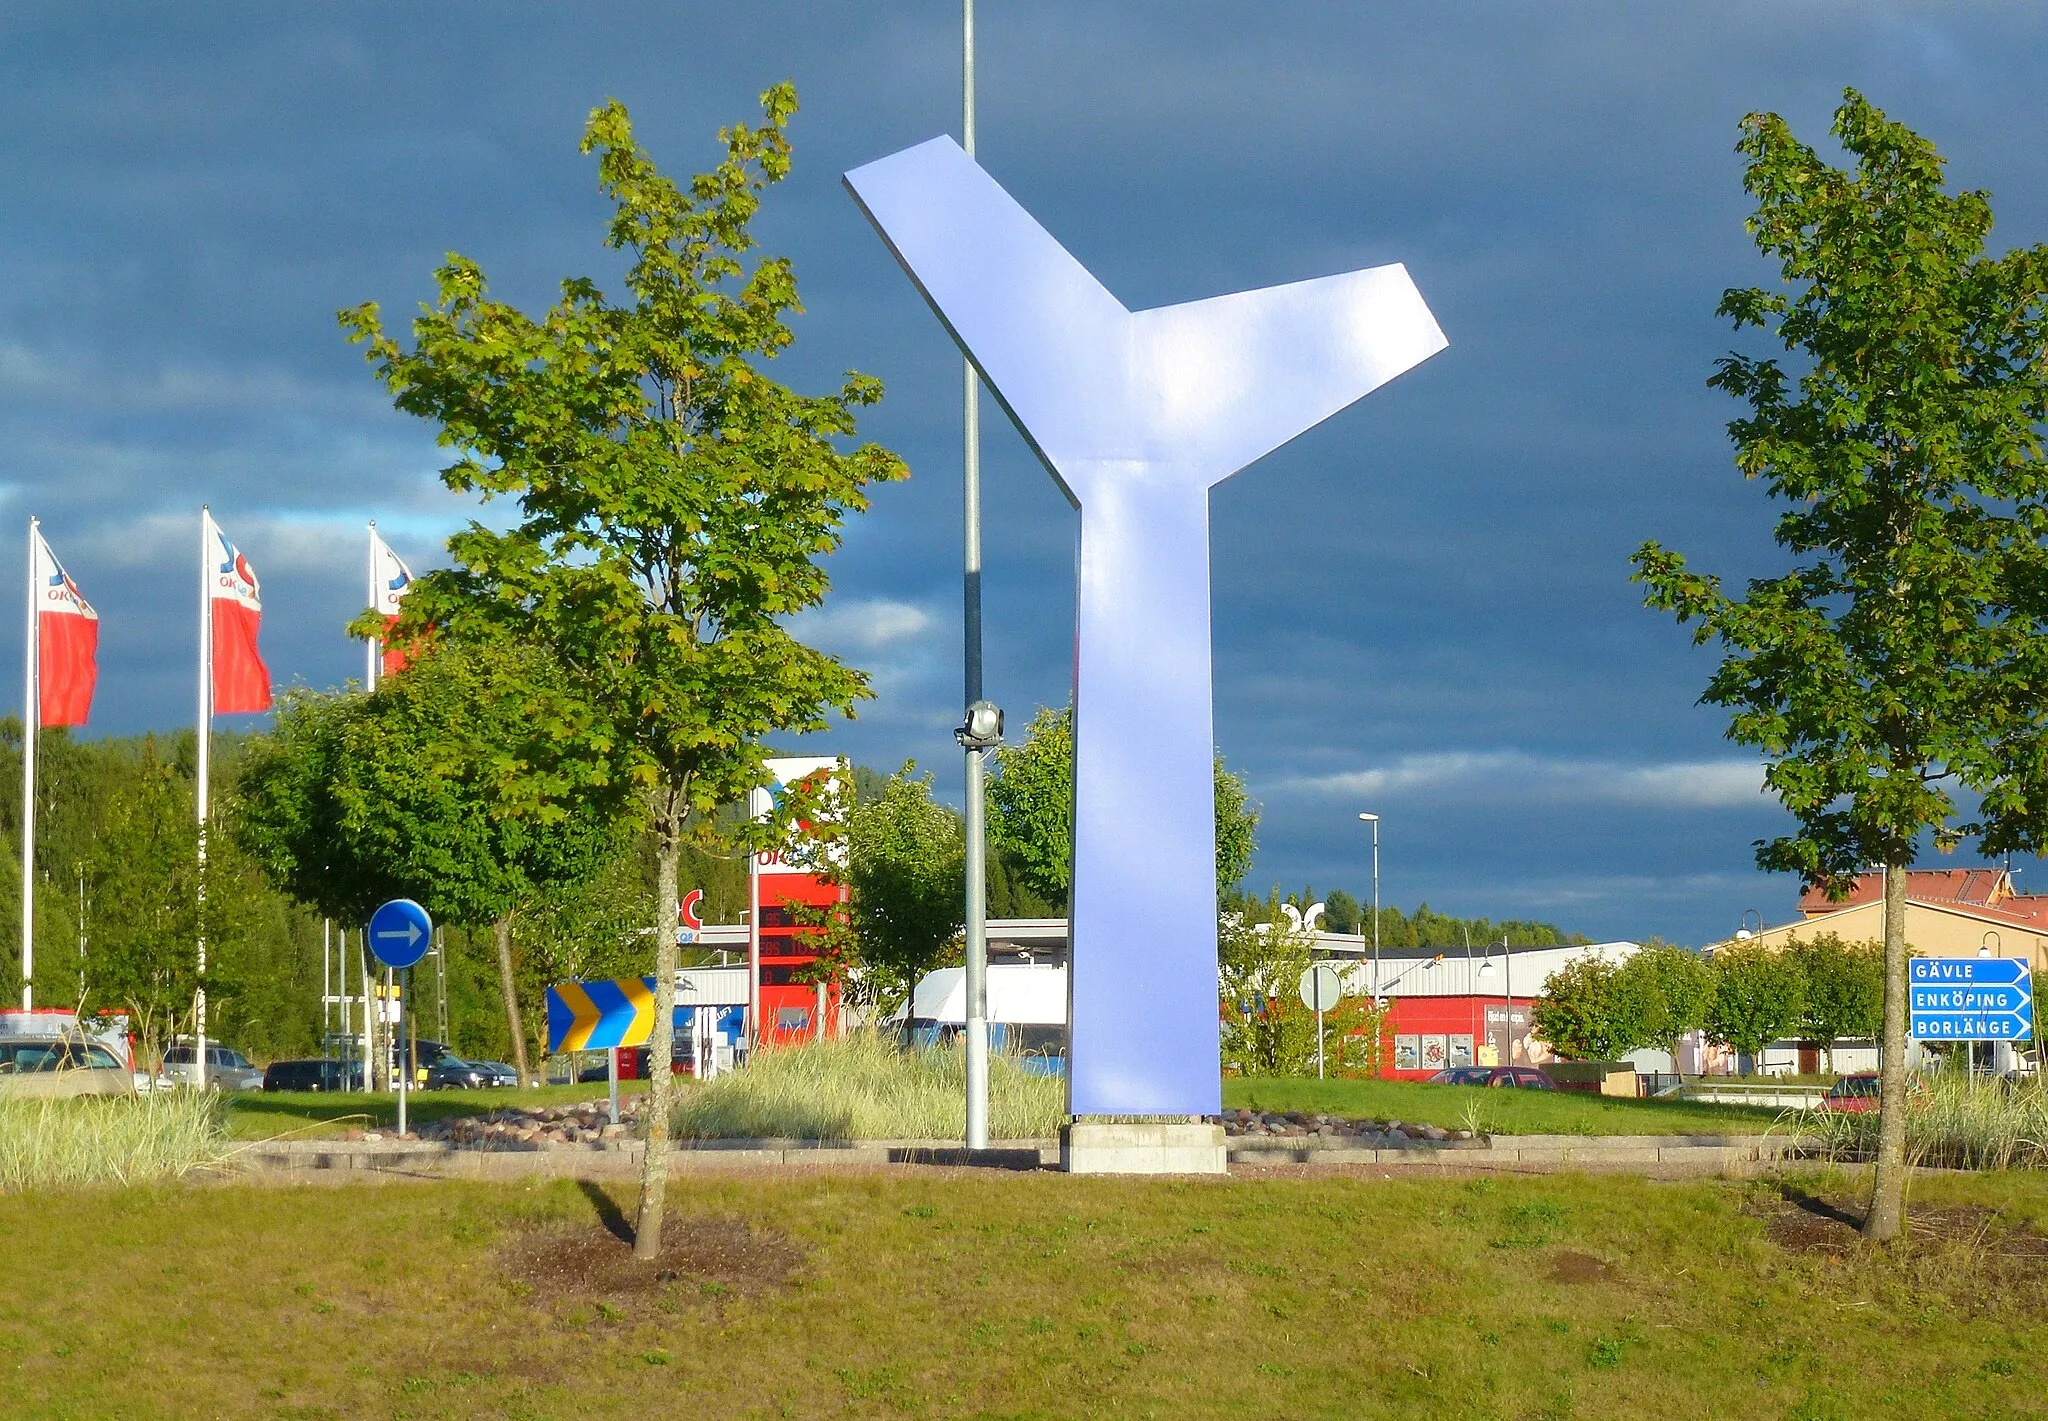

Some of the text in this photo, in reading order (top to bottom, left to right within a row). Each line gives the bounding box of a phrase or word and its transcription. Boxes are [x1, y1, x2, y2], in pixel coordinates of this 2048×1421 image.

[1916, 961, 1973, 978] GÄVLE
[1917, 990, 2008, 1007] ENKÖPING
[1917, 1017, 2010, 1035] BORLÄNGE
